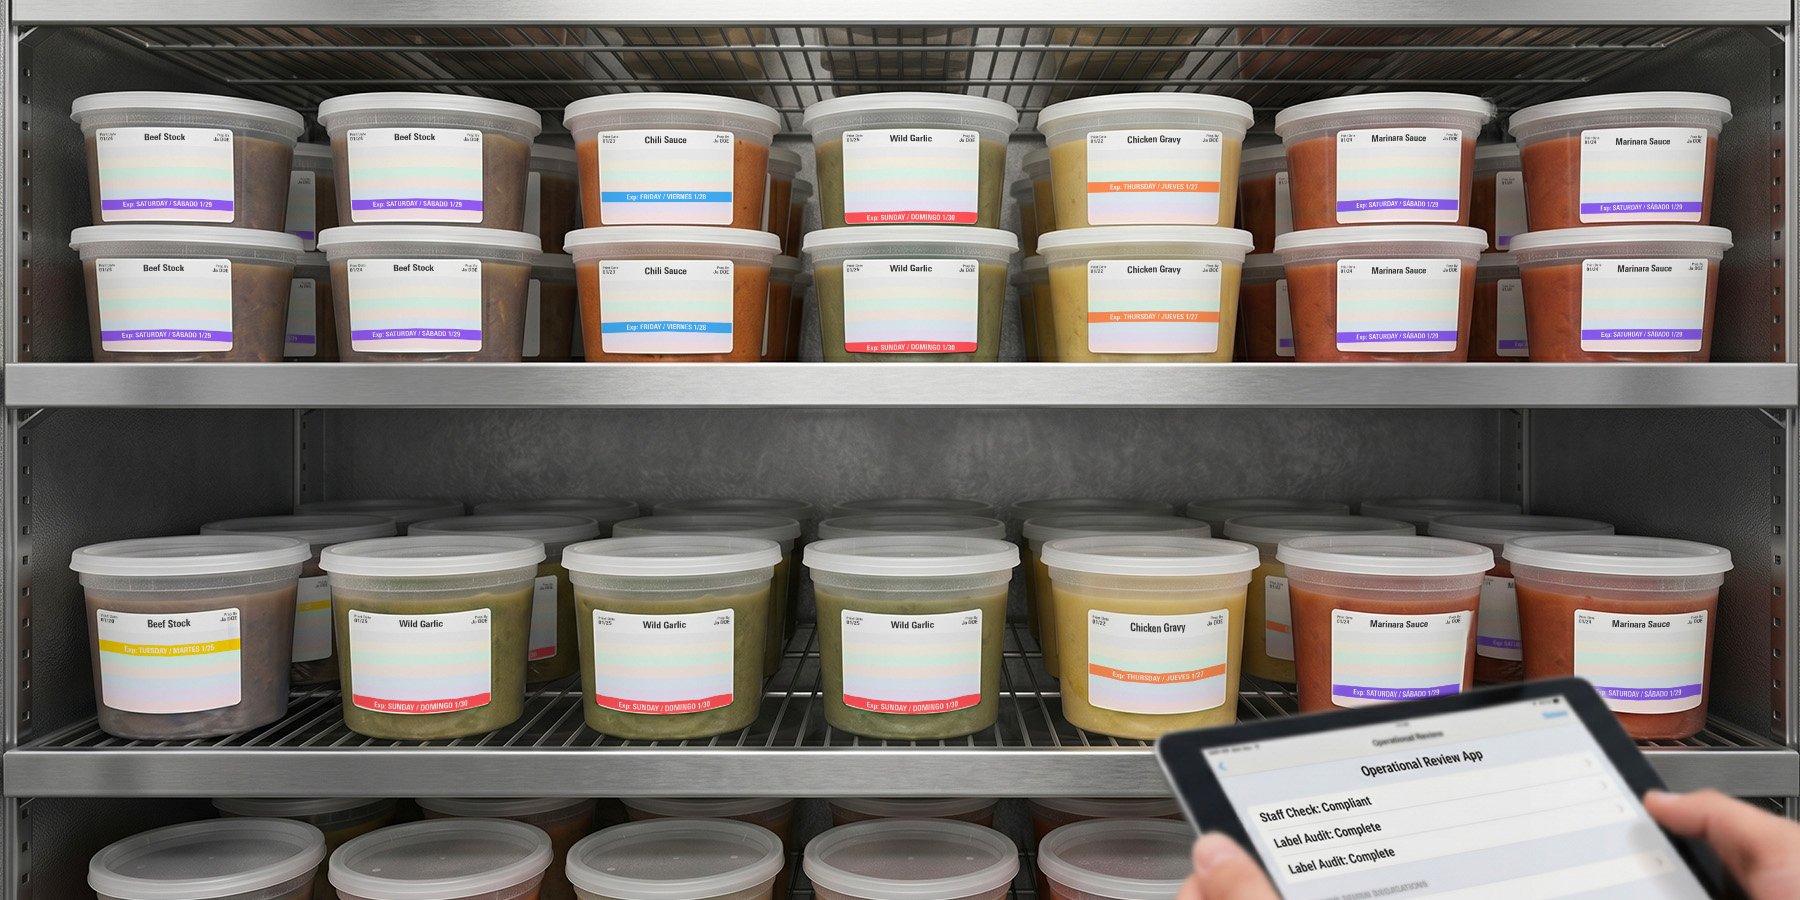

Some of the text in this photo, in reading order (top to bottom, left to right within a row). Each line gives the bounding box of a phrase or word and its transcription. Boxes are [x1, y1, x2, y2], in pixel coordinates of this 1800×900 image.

[144, 133, 185, 141] Beef Stock
[394, 133, 435, 141] Beef Stock
[645, 136, 687, 144] Chili Sauce
[890, 134, 932, 142] Wild Garlic
[1127, 135, 1181, 144] Chicken Gravy
[1405, 134, 1426, 142] Sauce
[1615, 138, 1647, 146] Marinara
[413, 264, 434, 272] Stock
[645, 267, 687, 275] Chili Sauce
[1160, 265, 1181, 275] Gravy
[1371, 267, 1403, 275] Marinara
[148, 619, 191, 628] Beef Stock
[420, 620, 443, 628] Garlic
[643, 621, 686, 629] Wild Garlic
[891, 621, 934, 629] Wild Garlic
[1130, 622, 1185, 633] Chicken Gravy
[1370, 620, 1428, 628] Marinara Sauce
[1612, 620, 1670, 628] Marinara Sauce
[1127, 674, 1160, 682] THURSDAY
[1191, 671, 1204, 679] 1/27
[374, 701, 386, 709] Exp:
[420, 702, 452, 711] DOMINGO
[455, 700, 468, 708] 1/30
[665, 703, 695, 711] DOMINGO
[913, 703, 944, 711] DOMINGO
[1360, 749, 1484, 778] Operational Review App
[1259, 796, 1372, 824] Staff Check: Compliant
[1273, 821, 1382, 849] Label Audit: Complete
[1288, 847, 1396, 875] Label Audit: Complete
